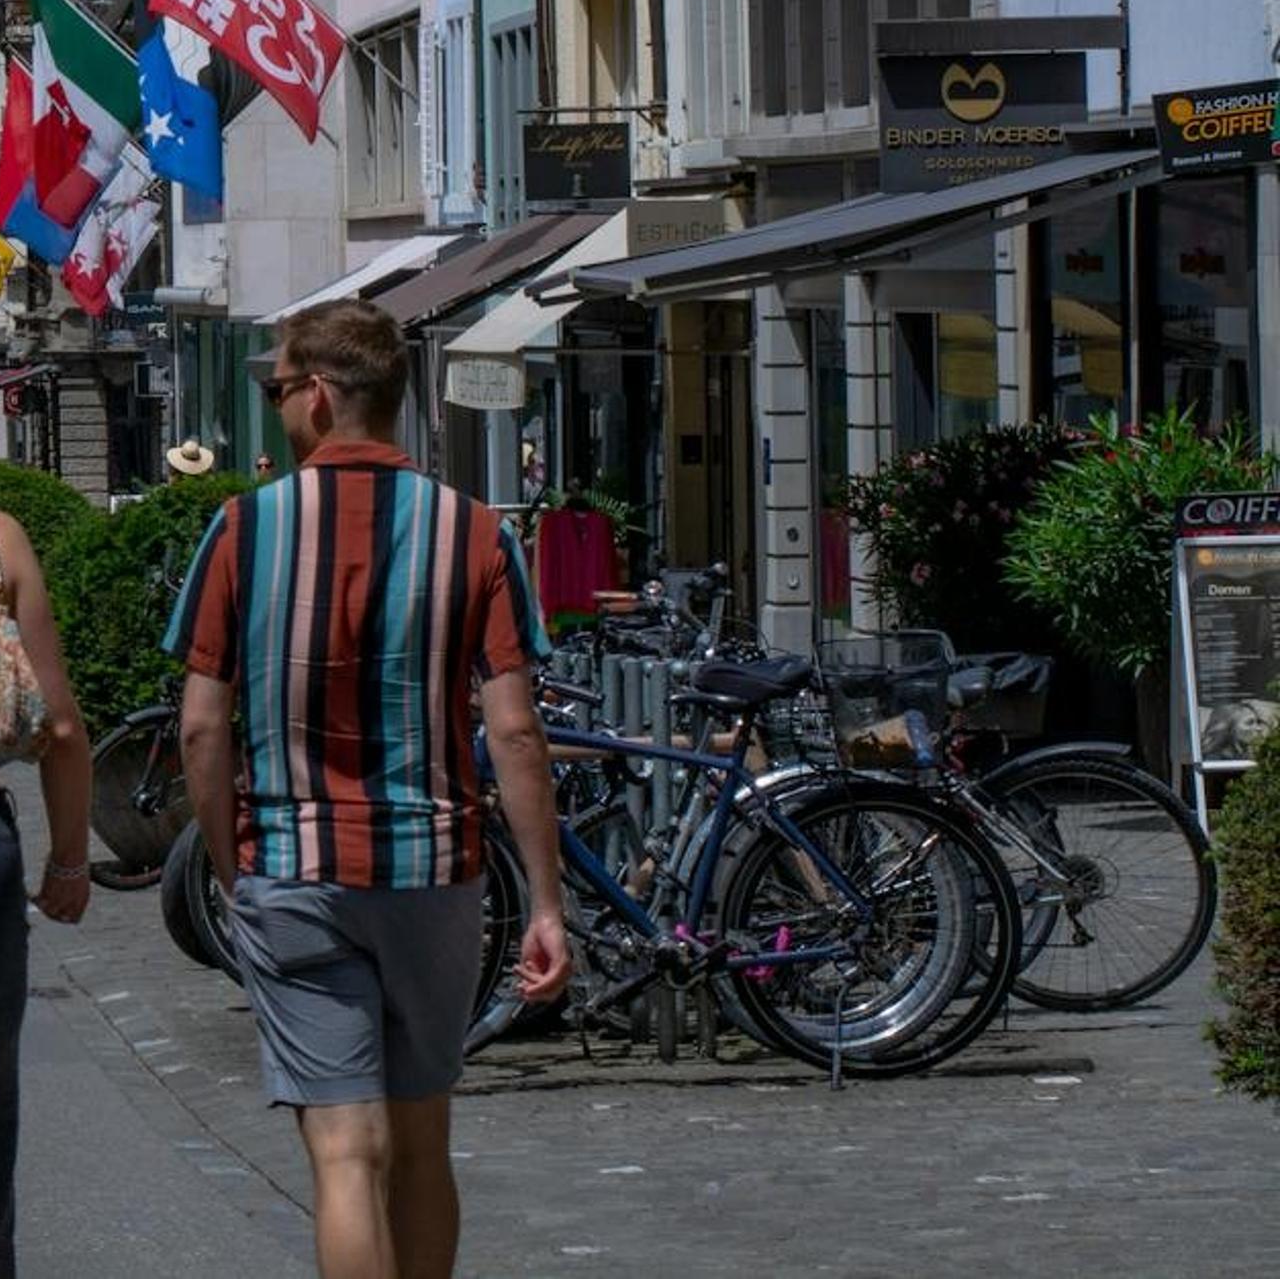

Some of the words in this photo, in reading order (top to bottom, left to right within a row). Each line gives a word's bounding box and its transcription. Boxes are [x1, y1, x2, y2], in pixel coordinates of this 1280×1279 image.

[1195, 93, 1265, 114] FASHION
[887, 127, 965, 147] BINDER
[924, 155, 1035, 170] GOLDSCHMIED
[1183, 497, 1280, 525] COIFF
[1208, 583, 1252, 596] Damen
